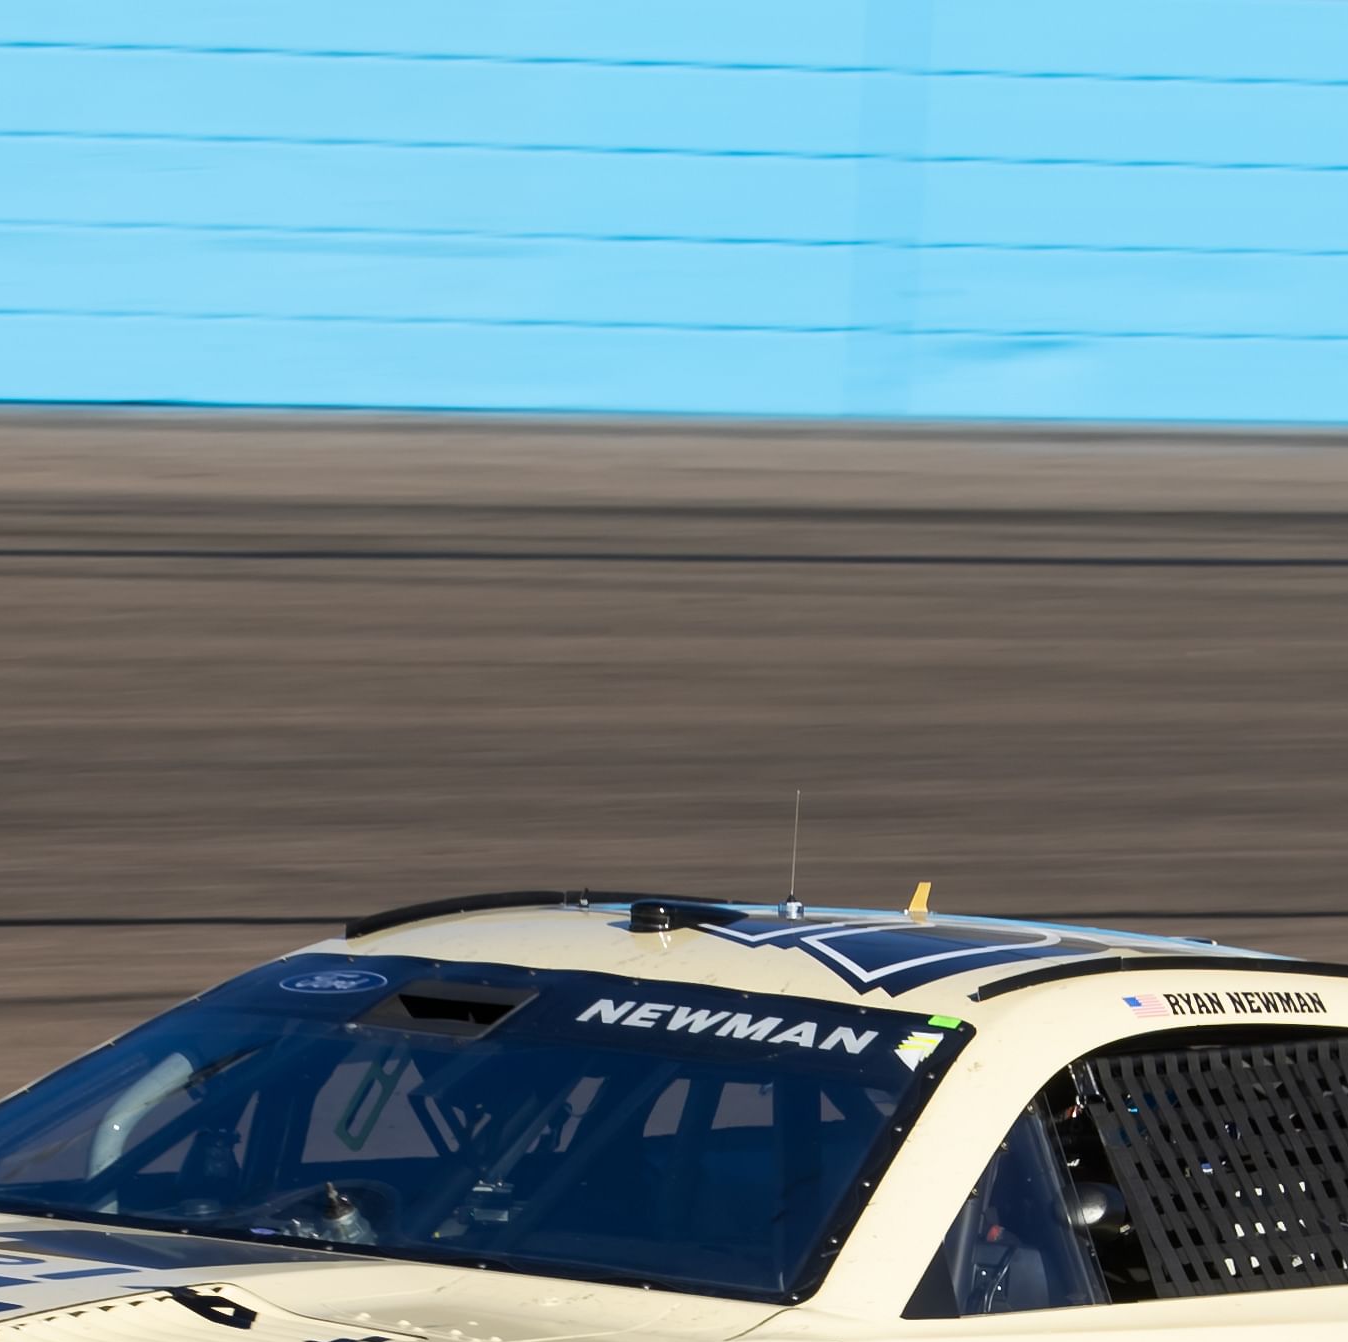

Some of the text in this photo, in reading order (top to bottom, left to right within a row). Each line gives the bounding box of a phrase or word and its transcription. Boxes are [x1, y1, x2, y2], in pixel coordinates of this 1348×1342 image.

[1162, 991, 1328, 1015] RYAN NEWMAN
[576, 999, 879, 1054] NEWMAN
